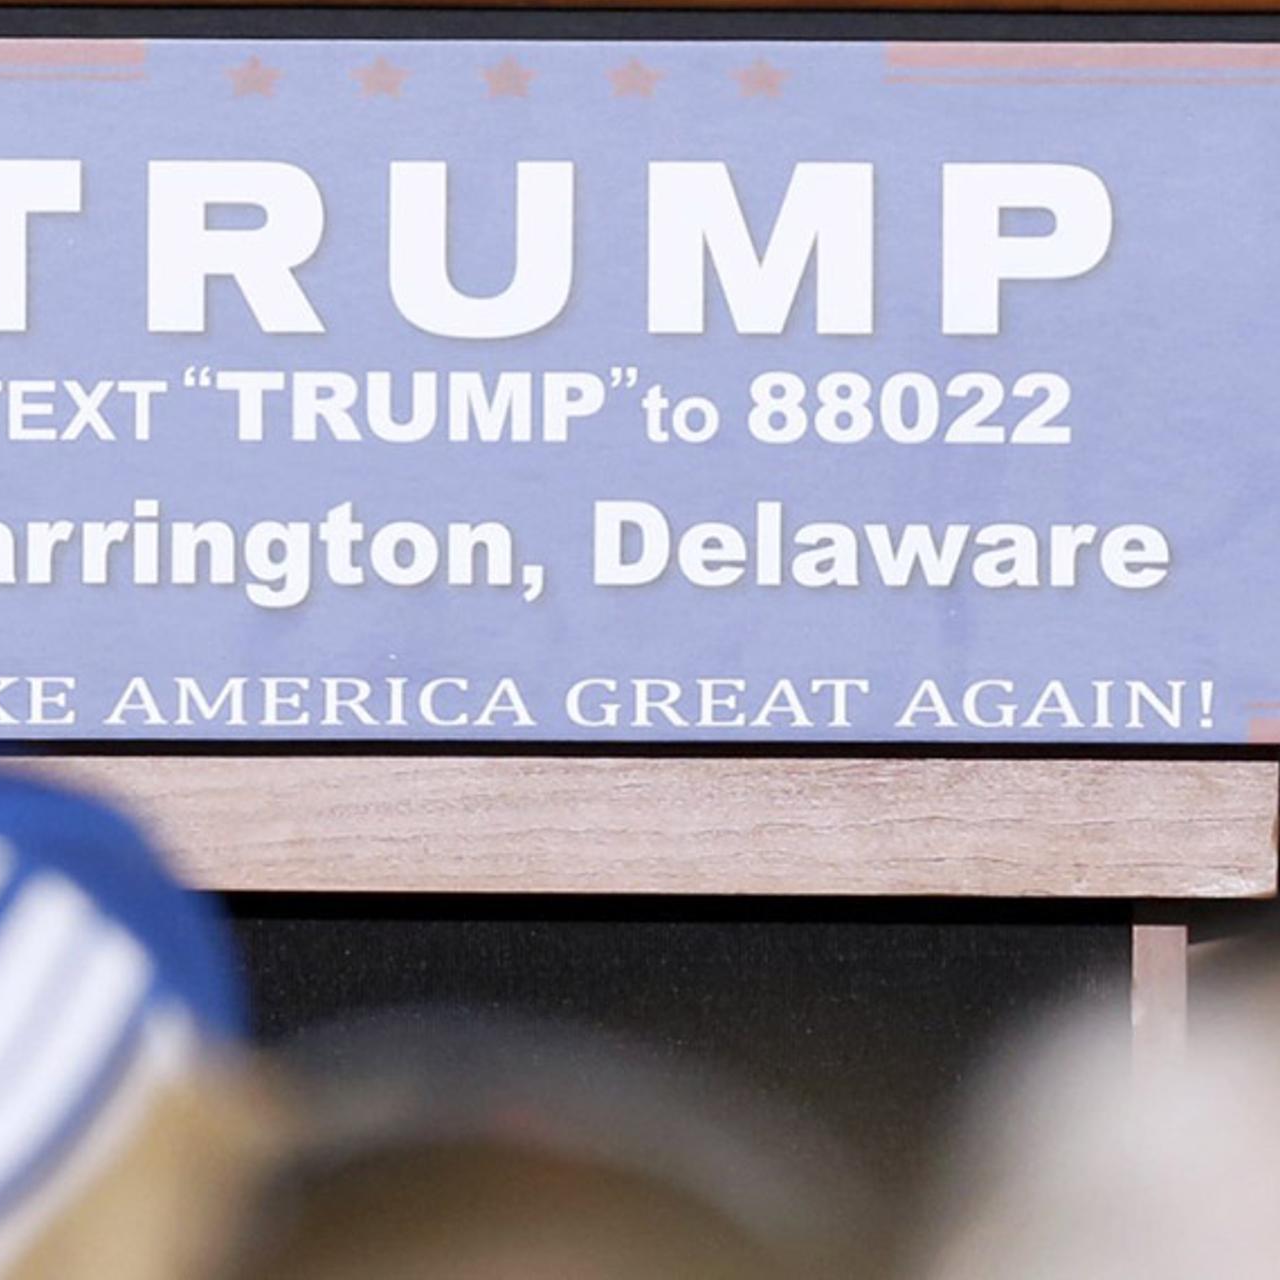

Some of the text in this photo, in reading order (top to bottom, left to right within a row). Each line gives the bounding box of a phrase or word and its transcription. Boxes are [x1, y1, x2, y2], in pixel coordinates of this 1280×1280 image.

[183, 365, 638, 443] “TRUMP”
[641, 383, 720, 444] to
[747, 371, 1072, 445] 88022
[593, 500, 1169, 589] Delaware
[103, 676, 537, 727] AMERICA
[565, 678, 870, 728] GREAT
[895, 678, 1214, 729] AGAIN!
